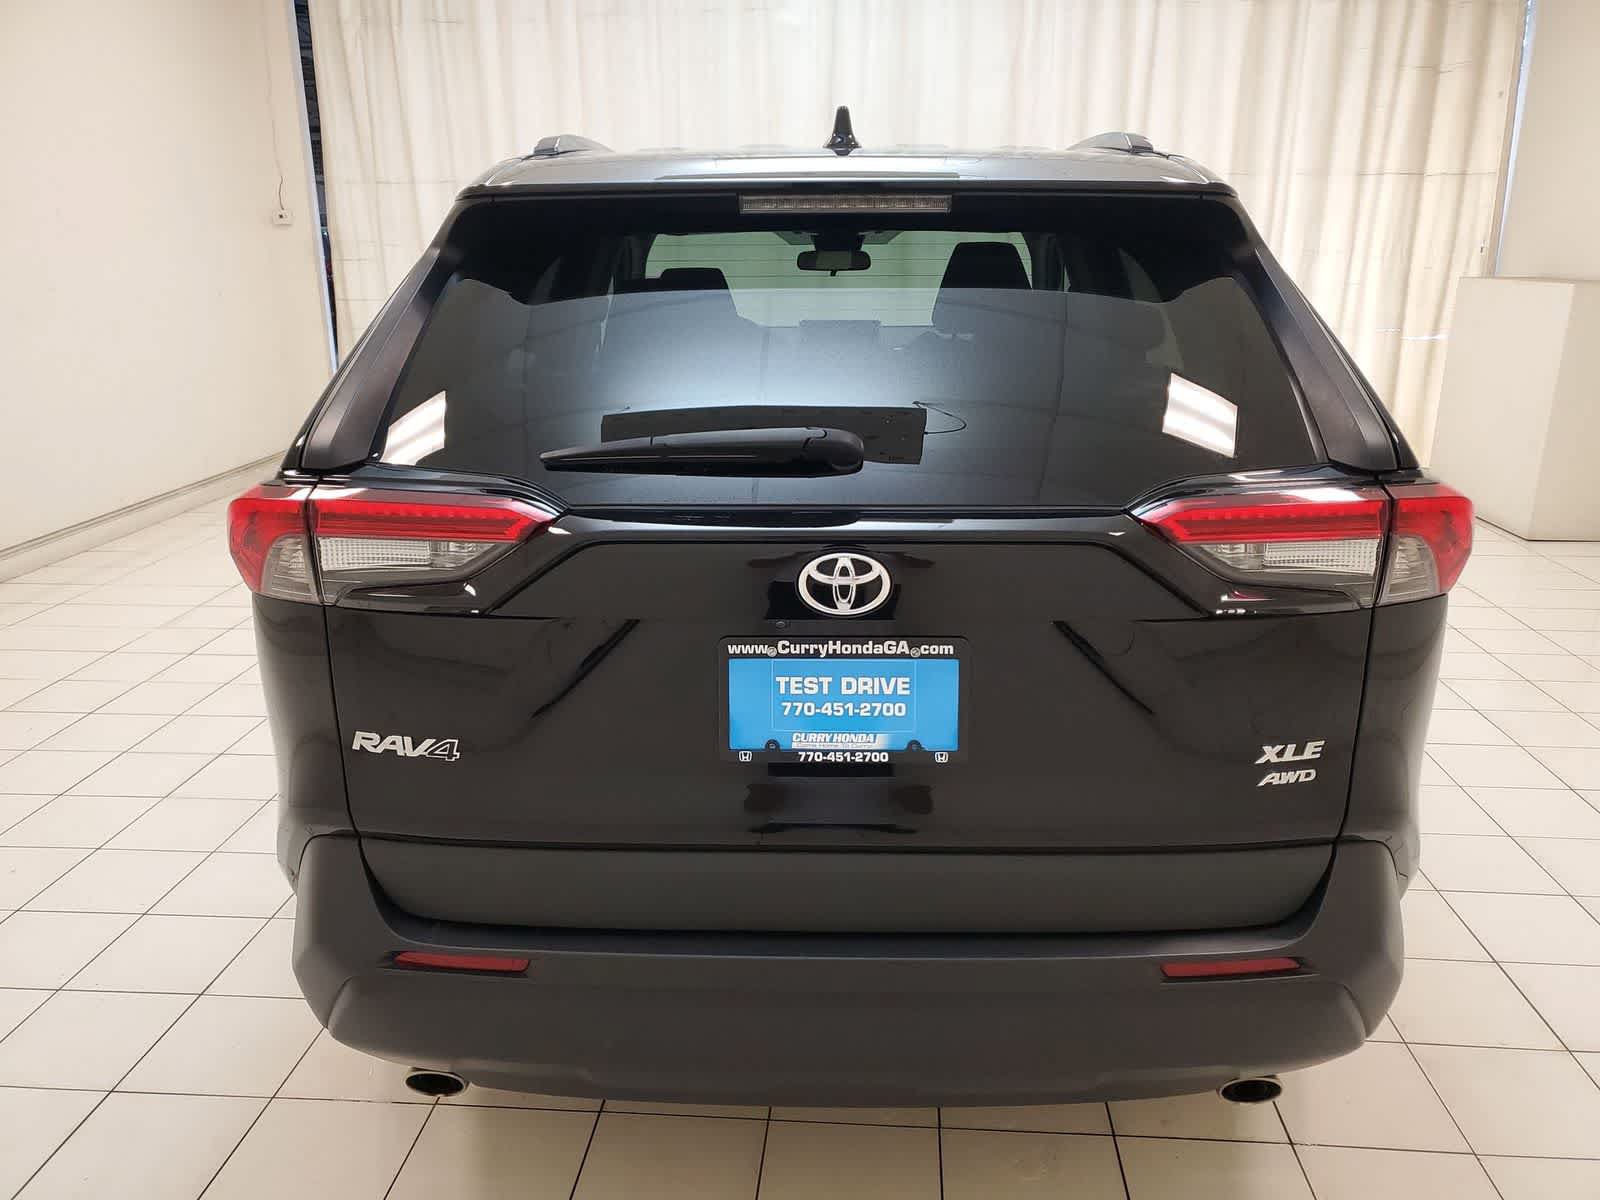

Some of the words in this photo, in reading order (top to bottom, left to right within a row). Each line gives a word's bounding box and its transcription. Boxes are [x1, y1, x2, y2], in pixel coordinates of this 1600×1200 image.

[728, 640, 954, 658] wwwCurryHondaGAcom
[776, 677, 832, 695] TEST
[841, 677, 911, 695] DRIVE
[781, 702, 906, 717] 770-451-2700
[352, 731, 460, 762] RAV4
[793, 732, 832, 743] CURRY
[832, 732, 874, 743] HONDA
[798, 752, 889, 763] 770-451-2700
[1254, 740, 1326, 765] XLE
[1256, 769, 1317, 787] AWD
